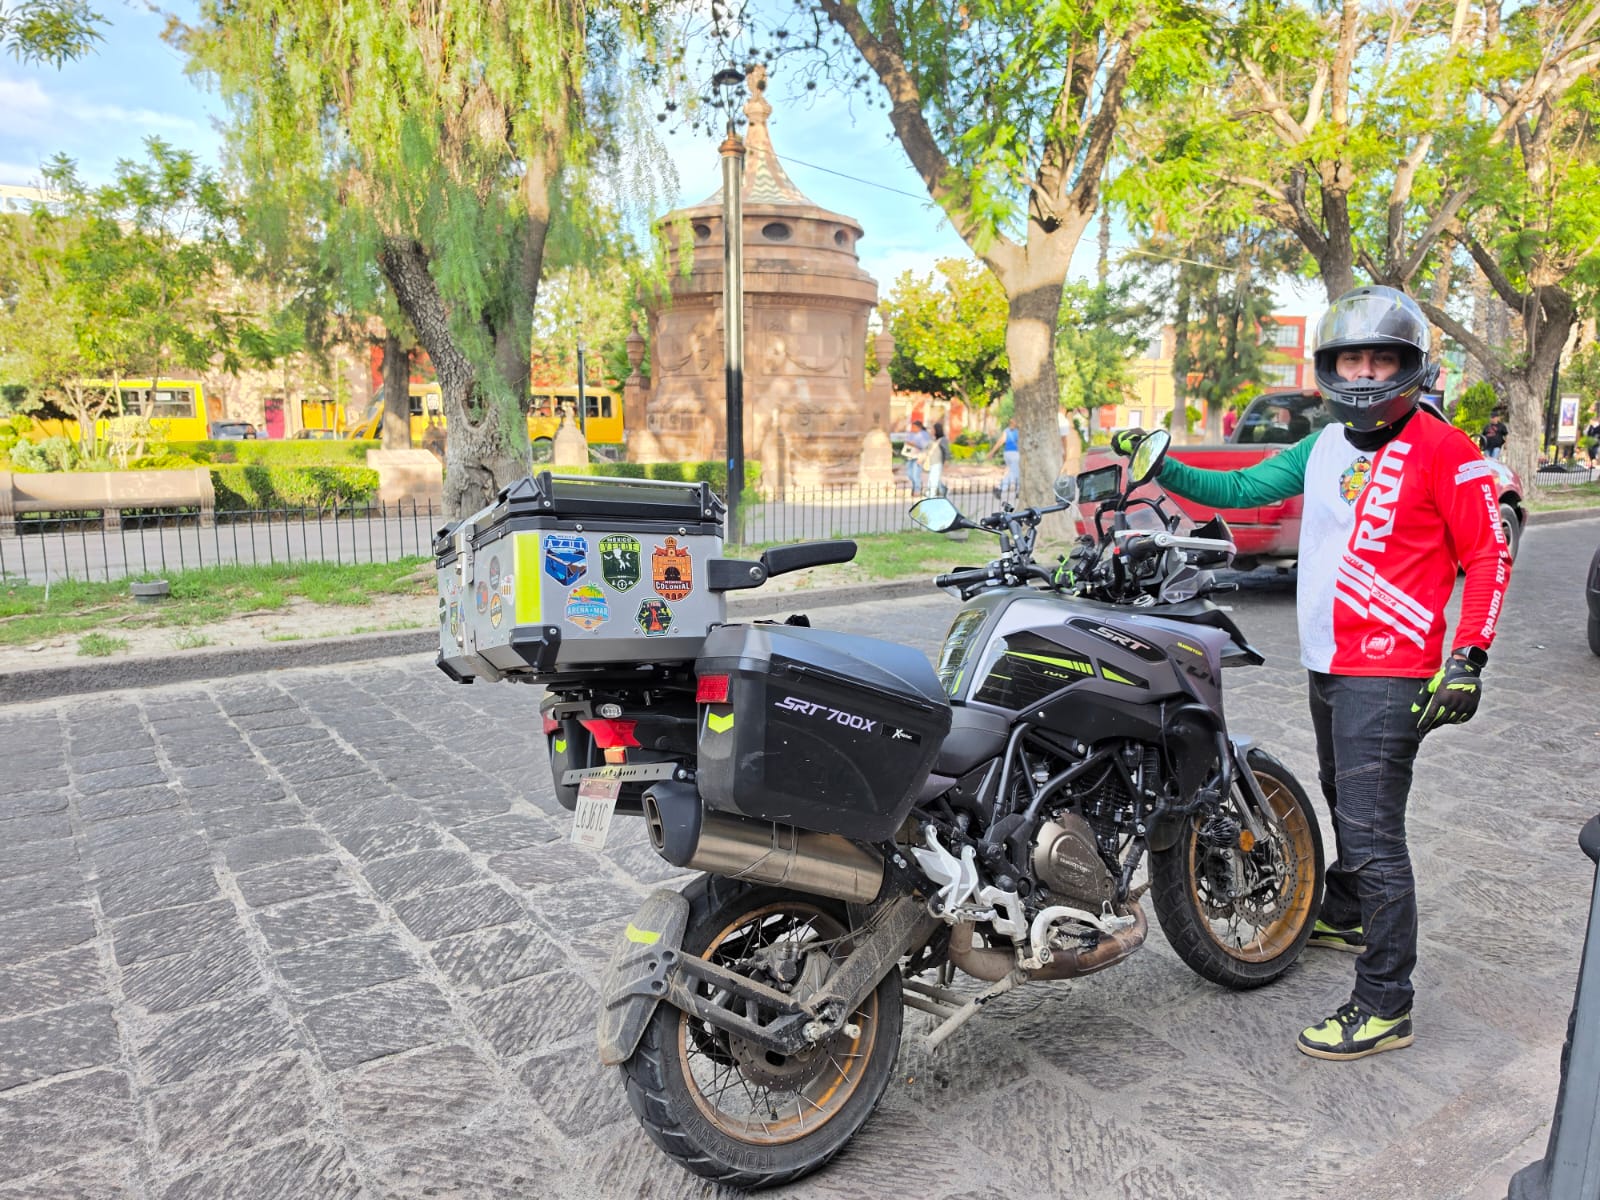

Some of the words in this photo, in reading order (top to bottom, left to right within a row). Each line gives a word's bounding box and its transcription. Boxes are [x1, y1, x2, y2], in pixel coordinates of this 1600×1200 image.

[1353, 440, 1412, 553] RRM
[655, 581, 690, 590] COLONIAL
[1089, 626, 1150, 650] SRT
[774, 696, 827, 716] SRT
[826, 708, 877, 732] 700X
